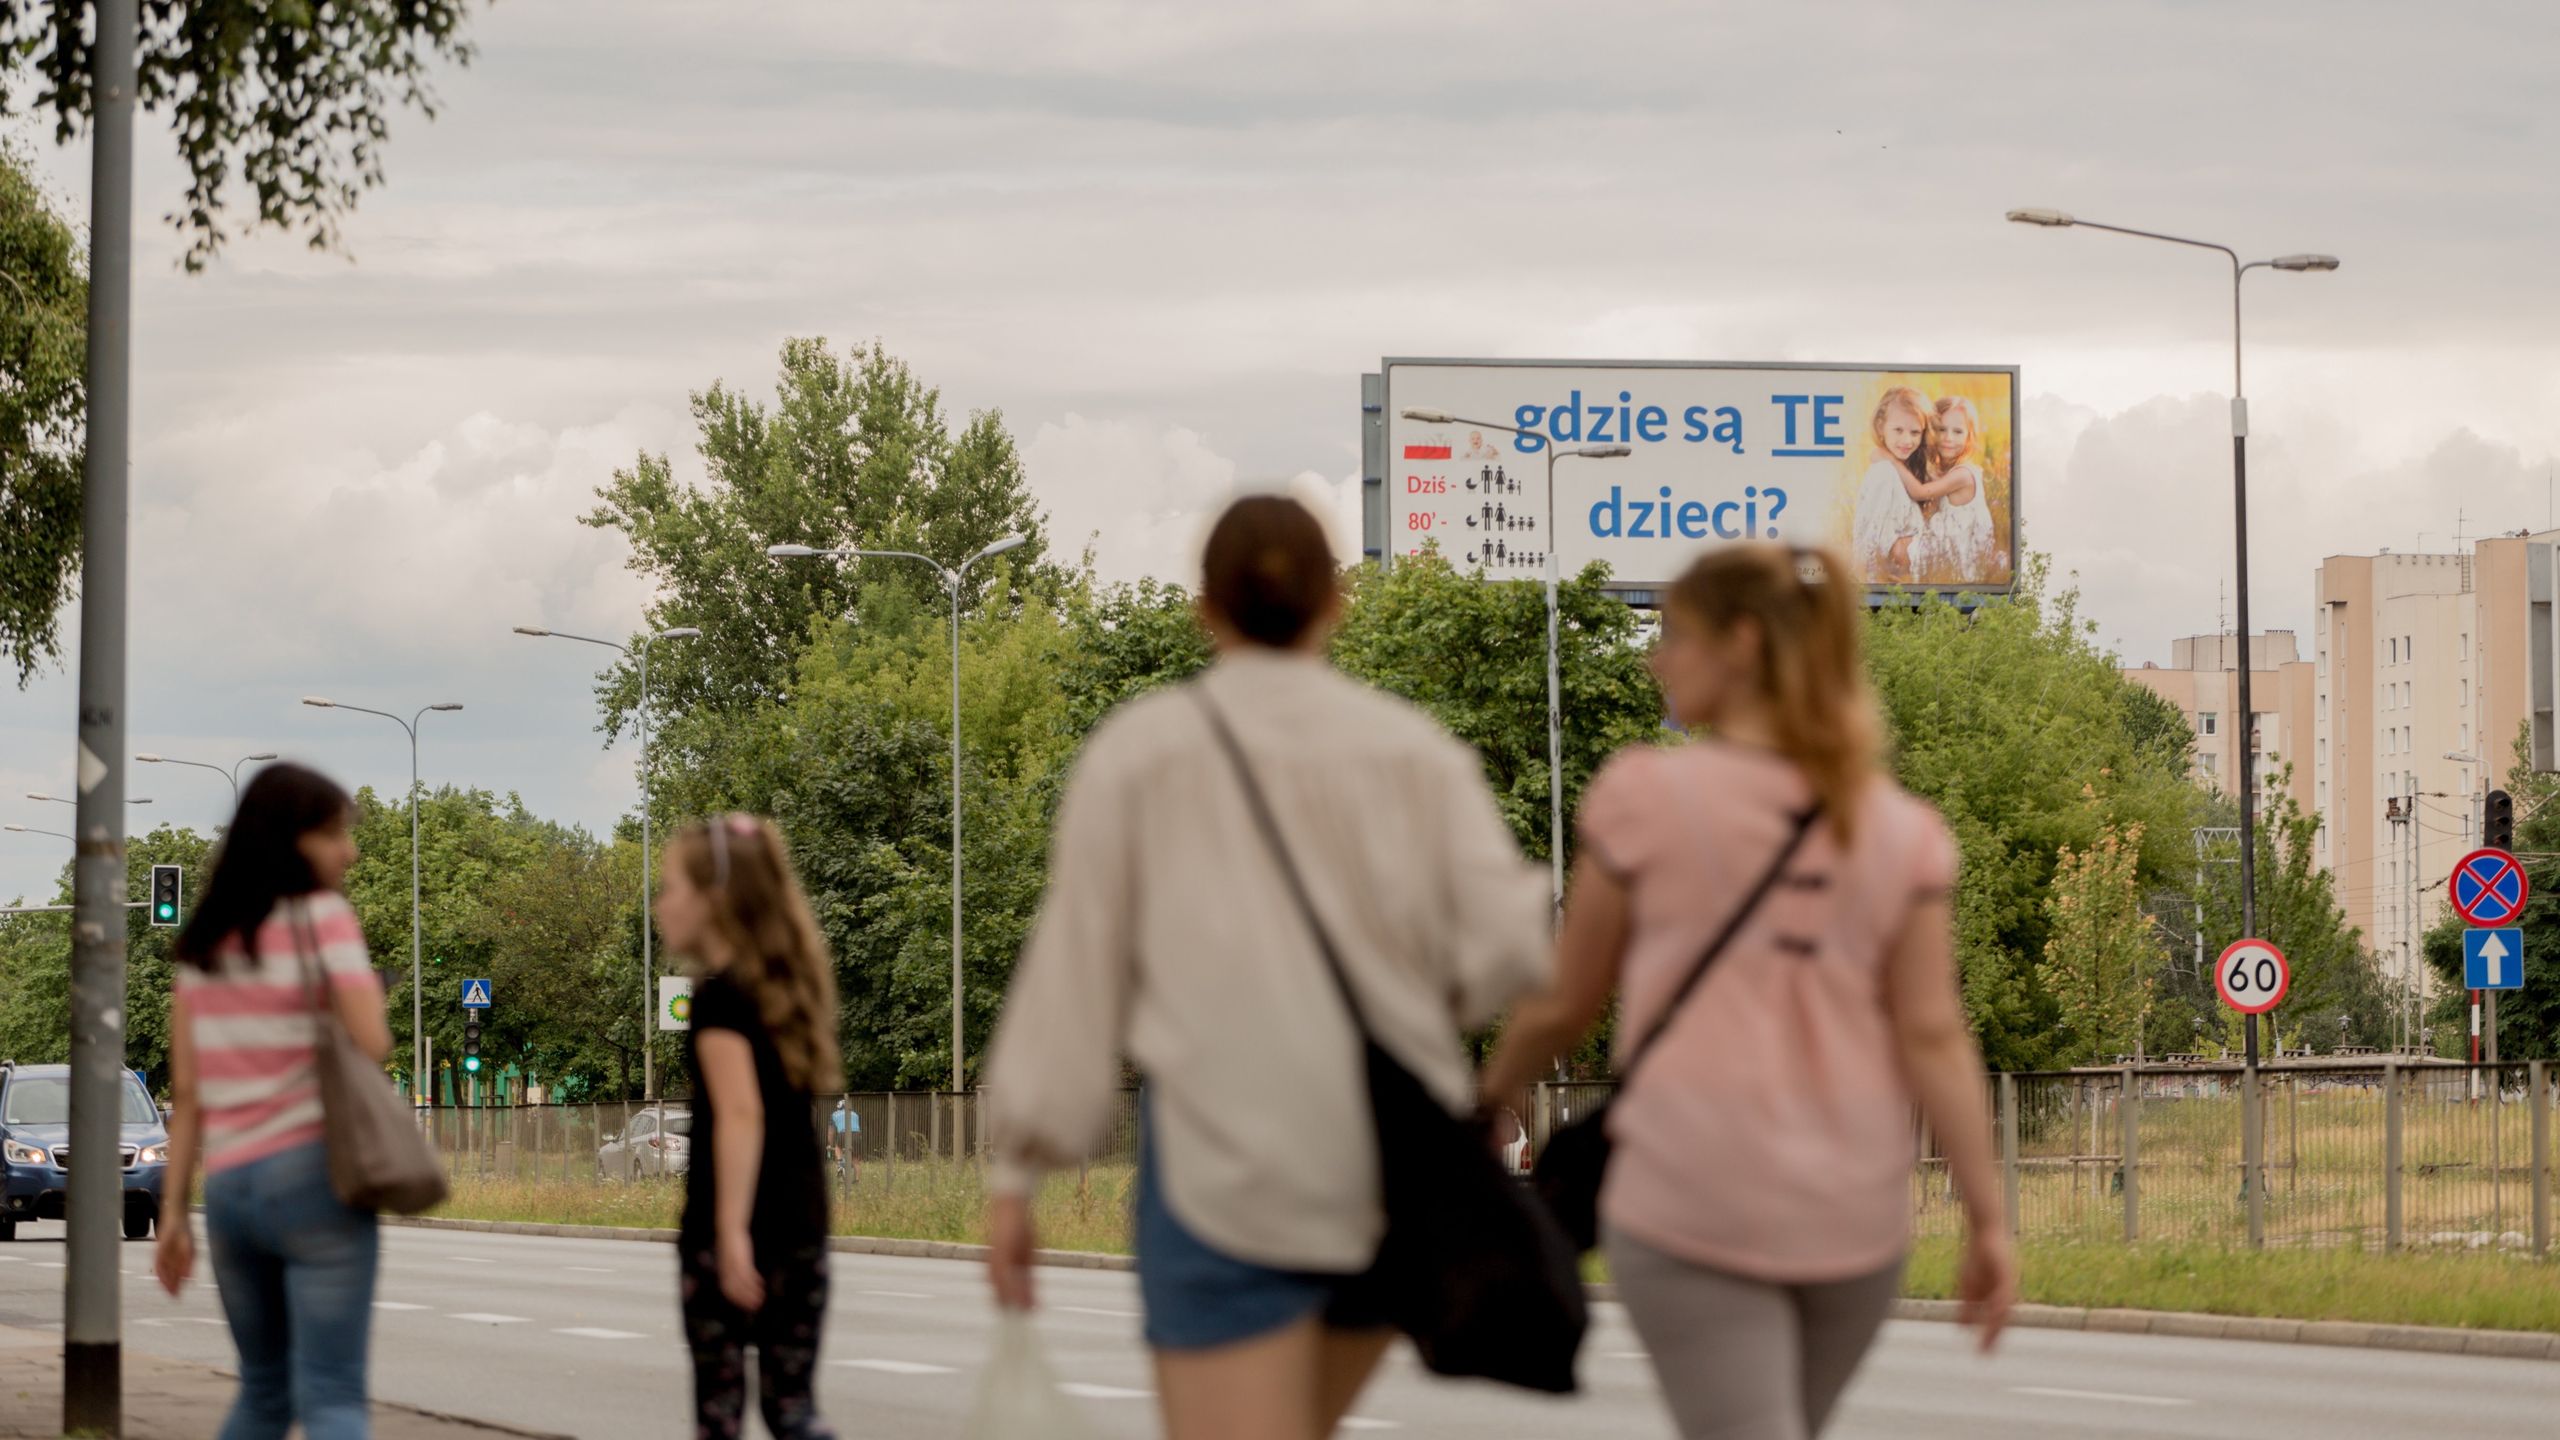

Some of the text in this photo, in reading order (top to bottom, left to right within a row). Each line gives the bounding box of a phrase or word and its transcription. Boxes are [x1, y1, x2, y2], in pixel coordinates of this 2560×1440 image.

[1514, 390, 1845, 455] gdzie są TE
[1407, 475, 1447, 494] Dziś
[1588, 485, 1788, 540] dzieci?
[2228, 957, 2277, 992] 60
